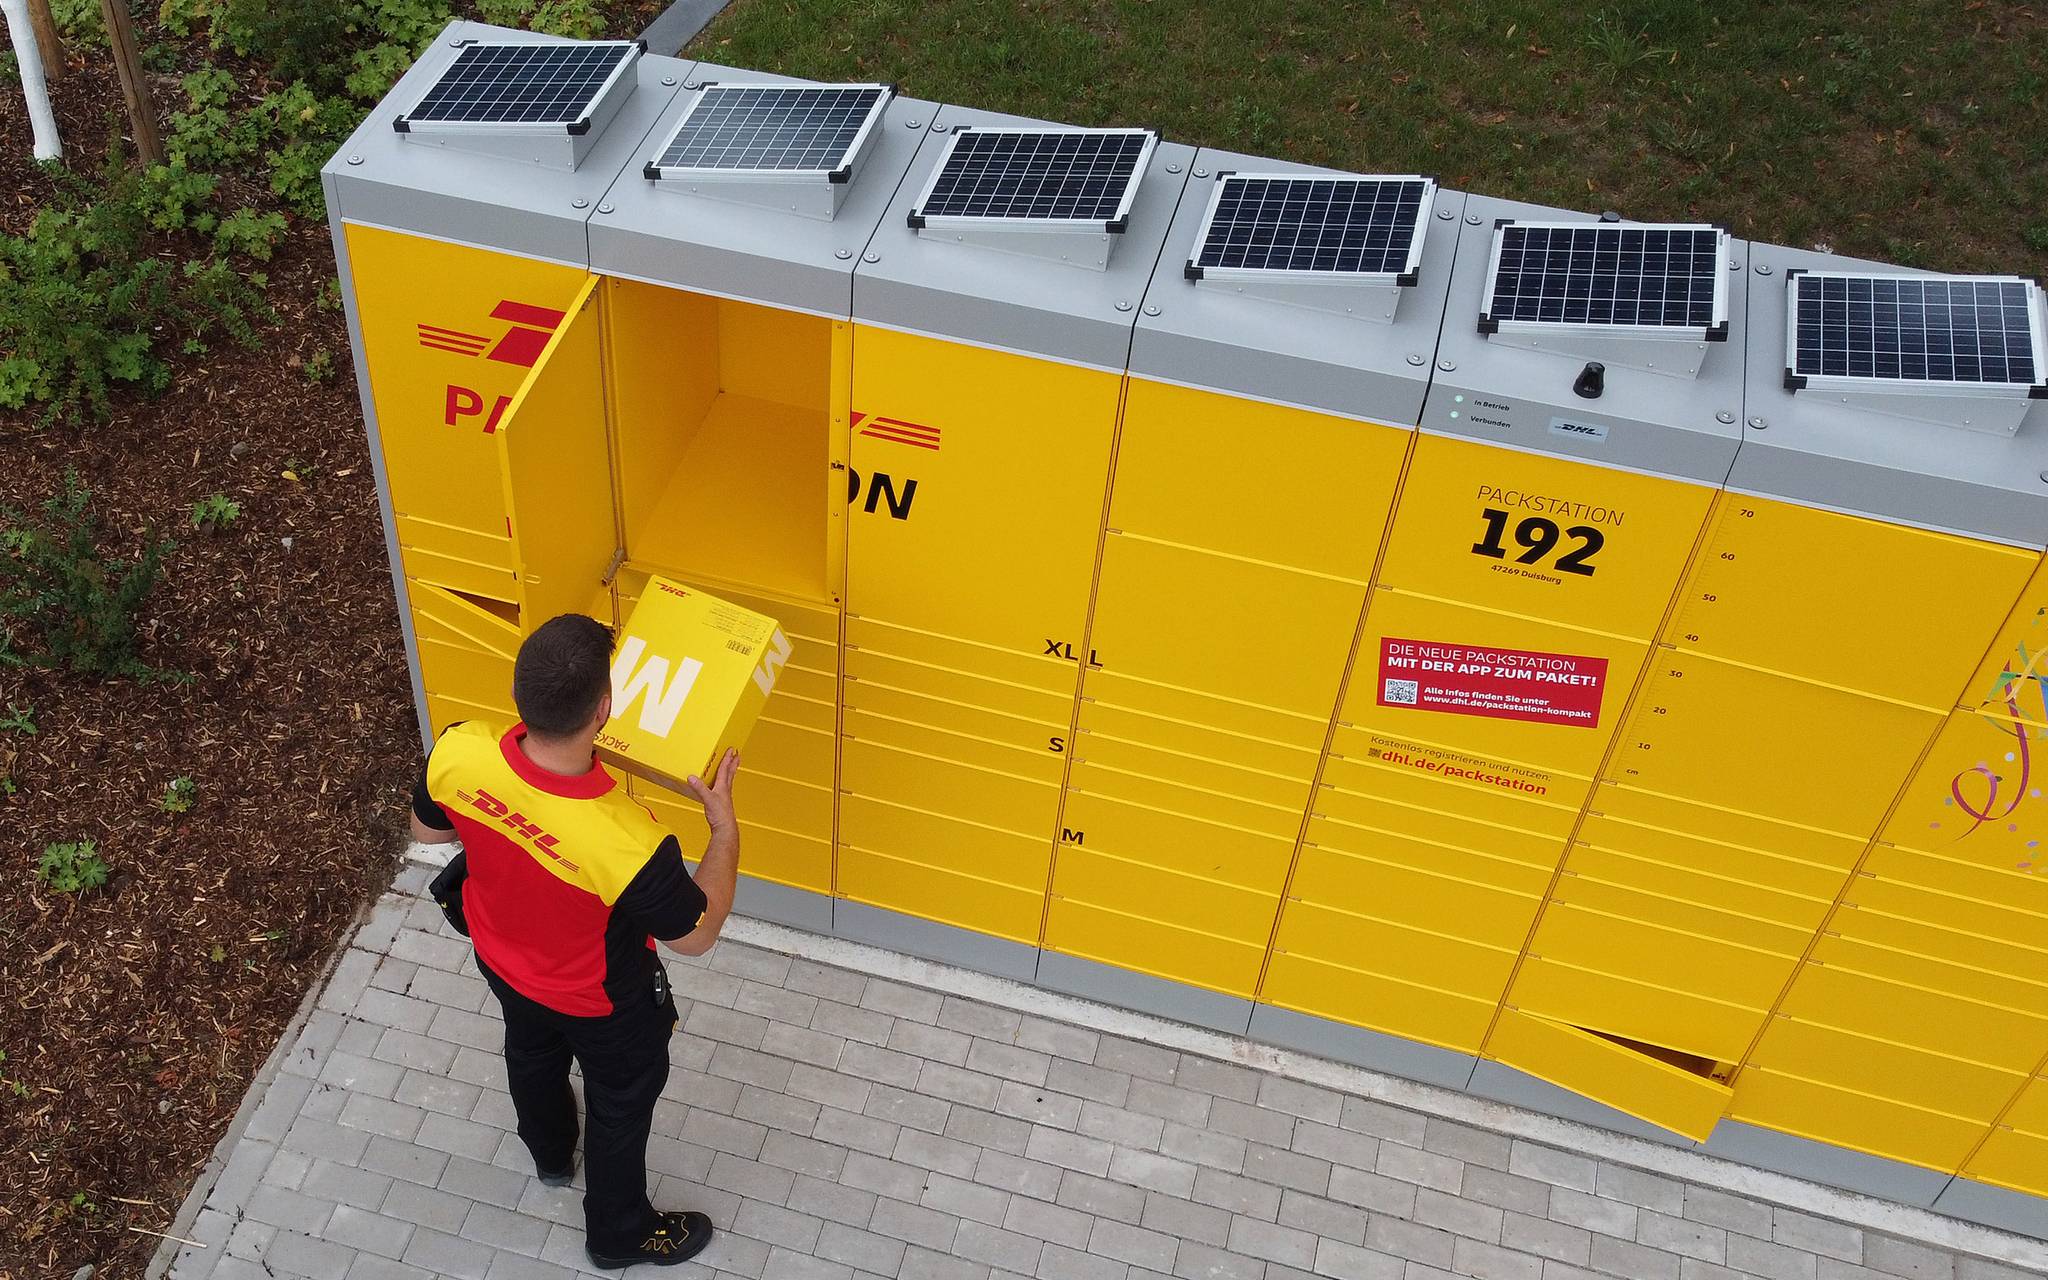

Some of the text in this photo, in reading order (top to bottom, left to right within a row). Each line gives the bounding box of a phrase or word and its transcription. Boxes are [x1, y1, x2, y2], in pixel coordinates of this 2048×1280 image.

[1474, 399, 1510, 412] In Betrieb
[1470, 416, 1511, 429] Verbunden
[1561, 423, 1597, 435] DHL
[1477, 485, 1625, 526] PACKSTATION
[1740, 508, 1754, 518] 70
[1471, 508, 1604, 576] 192
[1720, 552, 1735, 561] 60
[1491, 564, 1562, 585] 47269 Duisburg
[1702, 594, 1717, 603] 50
[1684, 633, 1699, 643] 40
[1043, 638, 1079, 661] XL
[1089, 649, 1104, 667] L
[1389, 643, 1576, 672] DIE NEUE PACKSTATION
[1387, 656, 1597, 687] MIT DER APP ZUM PAKET!
[1668, 670, 1683, 679] 30
[1424, 686, 1550, 706] Alle Infos finden Sie unter
[1423, 695, 1592, 719] www.dhl.de/packstation-kompakt
[1653, 706, 1667, 715] 20
[1048, 737, 1064, 752] S
[1637, 742, 1651, 751] 10
[1370, 736, 1552, 782] Kostenlos registrieren und nutzen:
[1381, 750, 1547, 795] dhl.de/packstation
[471, 788, 561, 862] DHL
[1061, 828, 1084, 845] M
